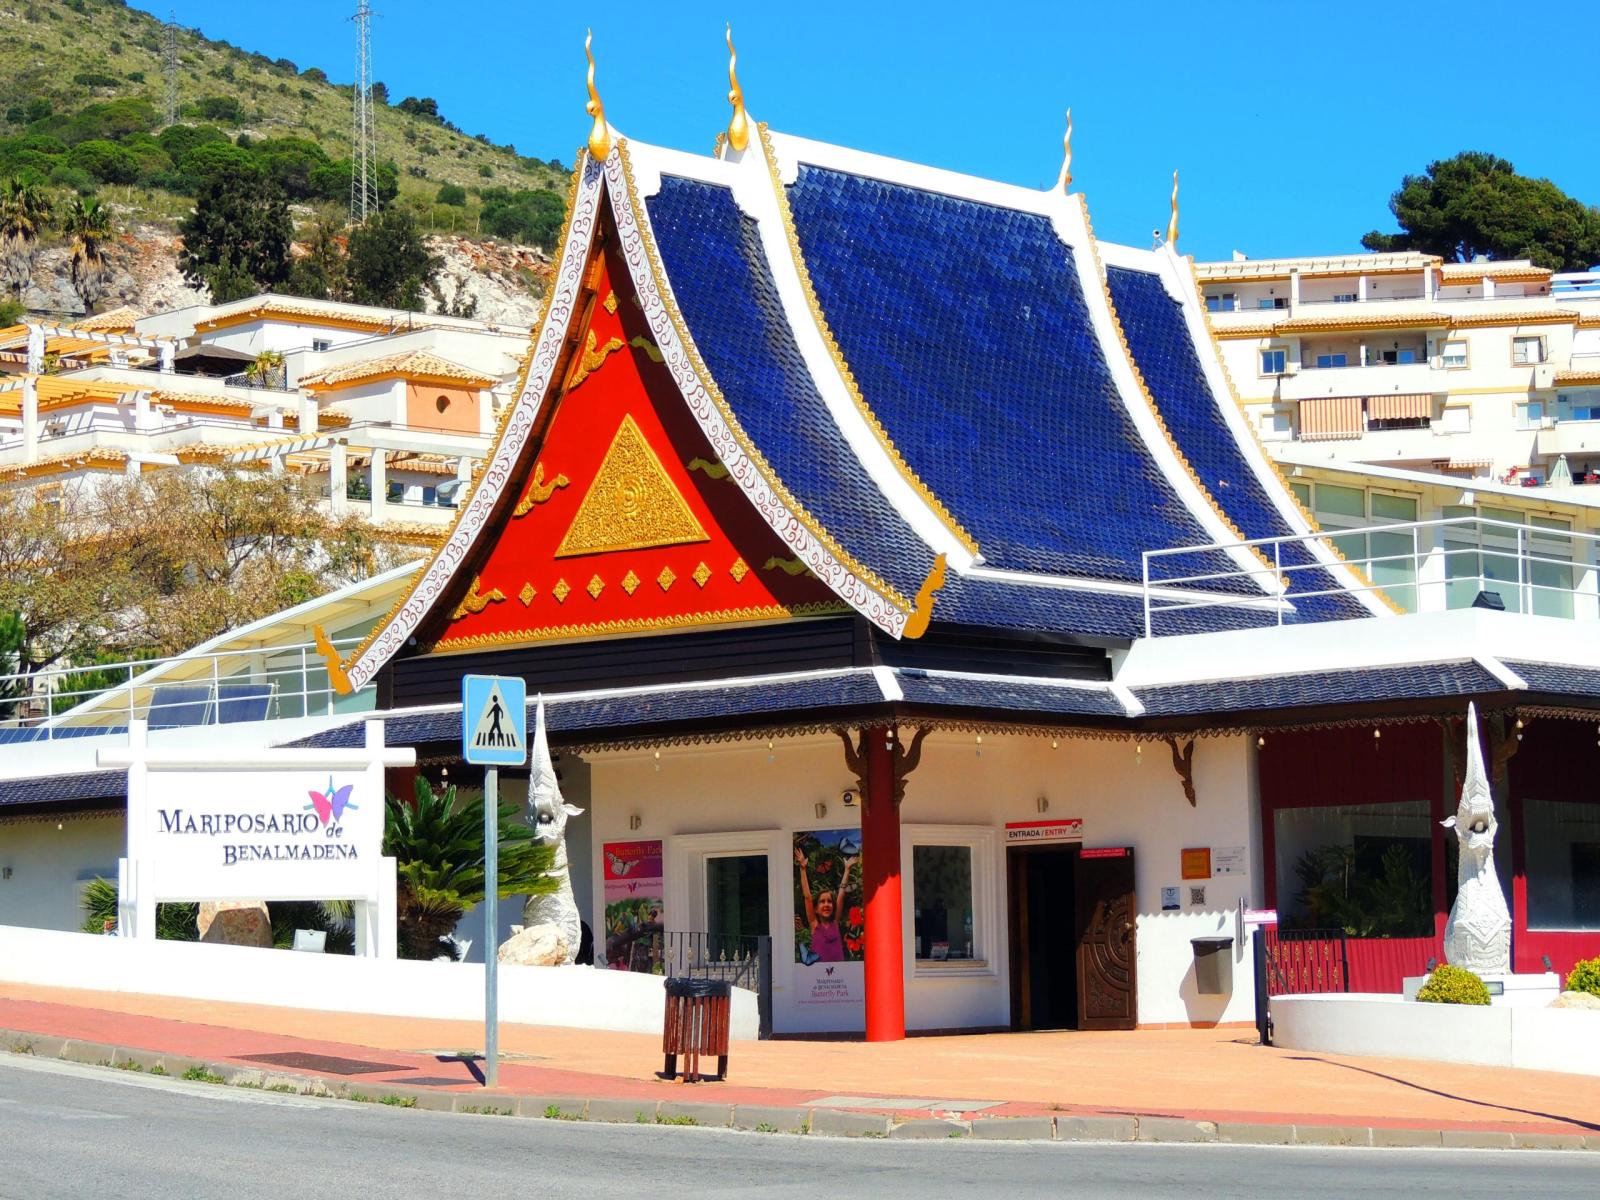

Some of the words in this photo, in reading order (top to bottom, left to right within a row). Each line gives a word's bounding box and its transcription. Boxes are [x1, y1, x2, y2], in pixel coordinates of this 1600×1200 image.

[157, 809, 319, 836] MARIPOSARIO
[326, 822, 343, 838] de
[1008, 830, 1040, 838] ENTRADA
[1045, 828, 1067, 836] ENTRY
[222, 844, 359, 866] BENALMADENA
